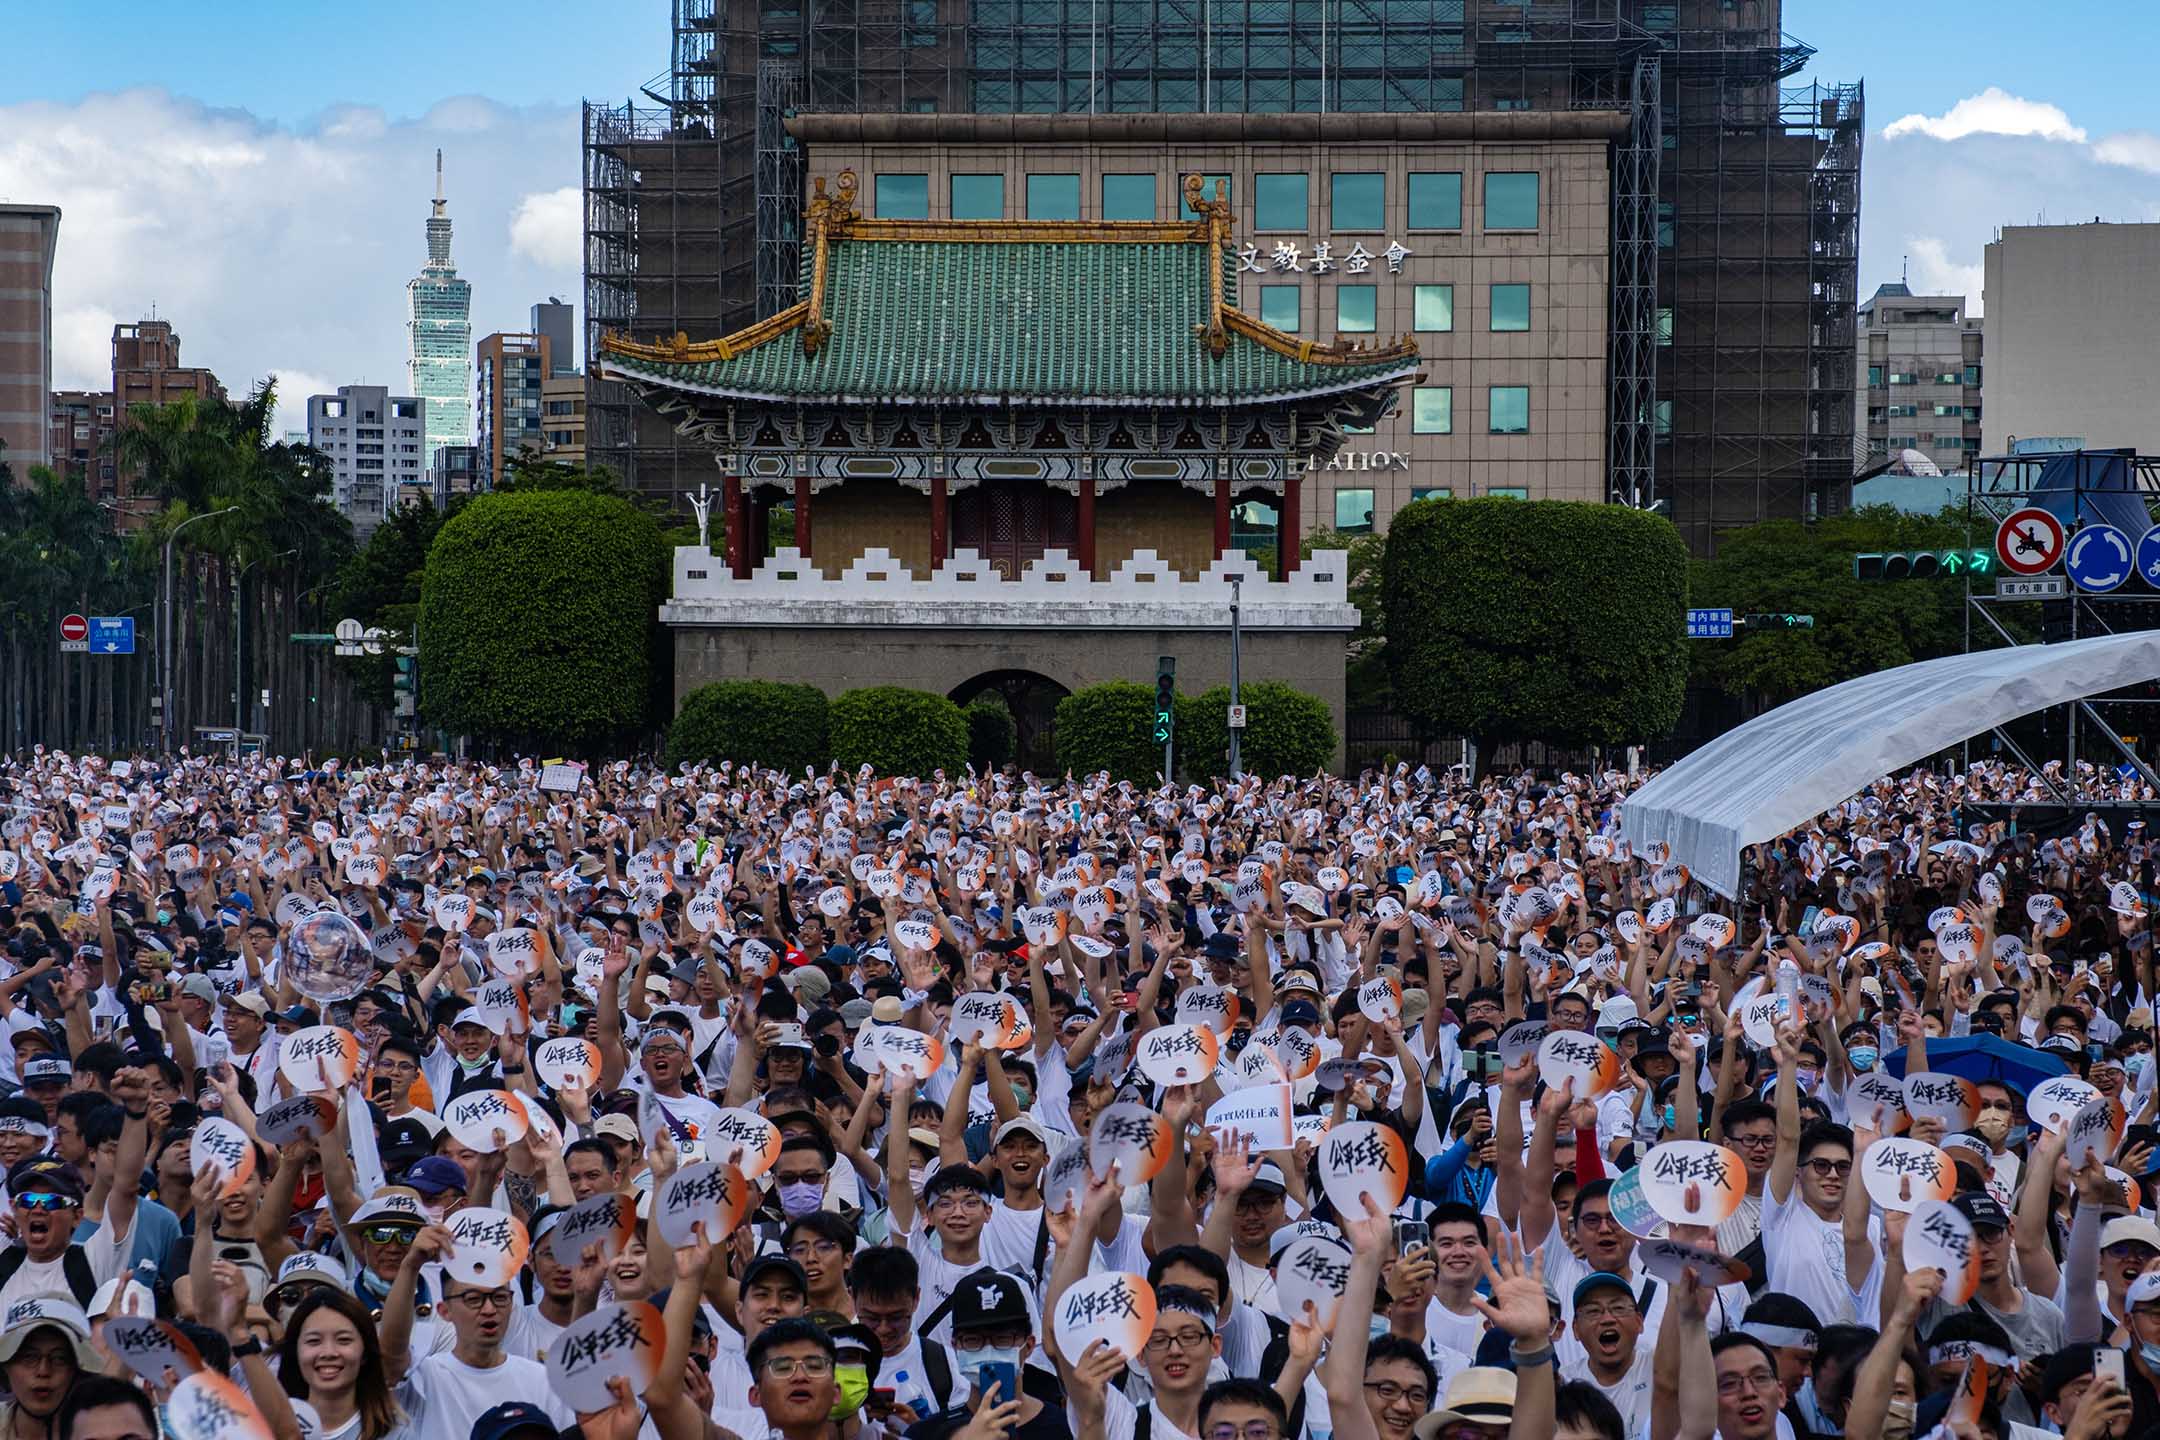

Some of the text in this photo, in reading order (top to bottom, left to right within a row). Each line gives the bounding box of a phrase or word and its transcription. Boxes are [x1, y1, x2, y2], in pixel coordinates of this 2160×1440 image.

[1237, 240, 1413, 275] 文教基金會
[1079, 888, 1109, 907] 公平正義
[1236, 877, 1266, 898] 公平正義
[375, 926, 410, 948] 公平正義
[496, 932, 538, 953] 公平正義
[484, 986, 520, 1008] 公平正義
[1186, 990, 1230, 1016] 公平正義
[1363, 979, 1397, 1003] 公平正義
[960, 998, 1006, 1029] 公平正義
[290, 1030, 348, 1060] 公平正義
[883, 1032, 932, 1060] 公平正義
[1150, 1025, 1208, 1055] 公平正義
[1287, 1031, 1315, 1067] 公平正義
[1509, 1024, 1548, 1044] 公平正義
[545, 1042, 593, 1068] 公平正義
[1551, 1036, 1604, 1076] 公平正義
[1911, 1078, 1970, 1106] 公平正義
[266, 1098, 325, 1125] 公平正義
[455, 1092, 516, 1124] 公平正義
[2072, 1103, 2116, 1140] 公平正義
[718, 1114, 772, 1158] 公平正義
[1100, 1114, 1156, 1158] 公平正義
[1329, 1129, 1395, 1174] 公平正義
[1654, 1149, 1732, 1191] 公平正義
[1876, 1146, 1942, 1188] 公平正義
[667, 1167, 732, 1210] 公平正義
[562, 1196, 623, 1234] 公平正義
[453, 1216, 514, 1256] 公平正義
[1066, 1276, 1140, 1326] 公平正義
[561, 1308, 650, 1371] 公平正義
